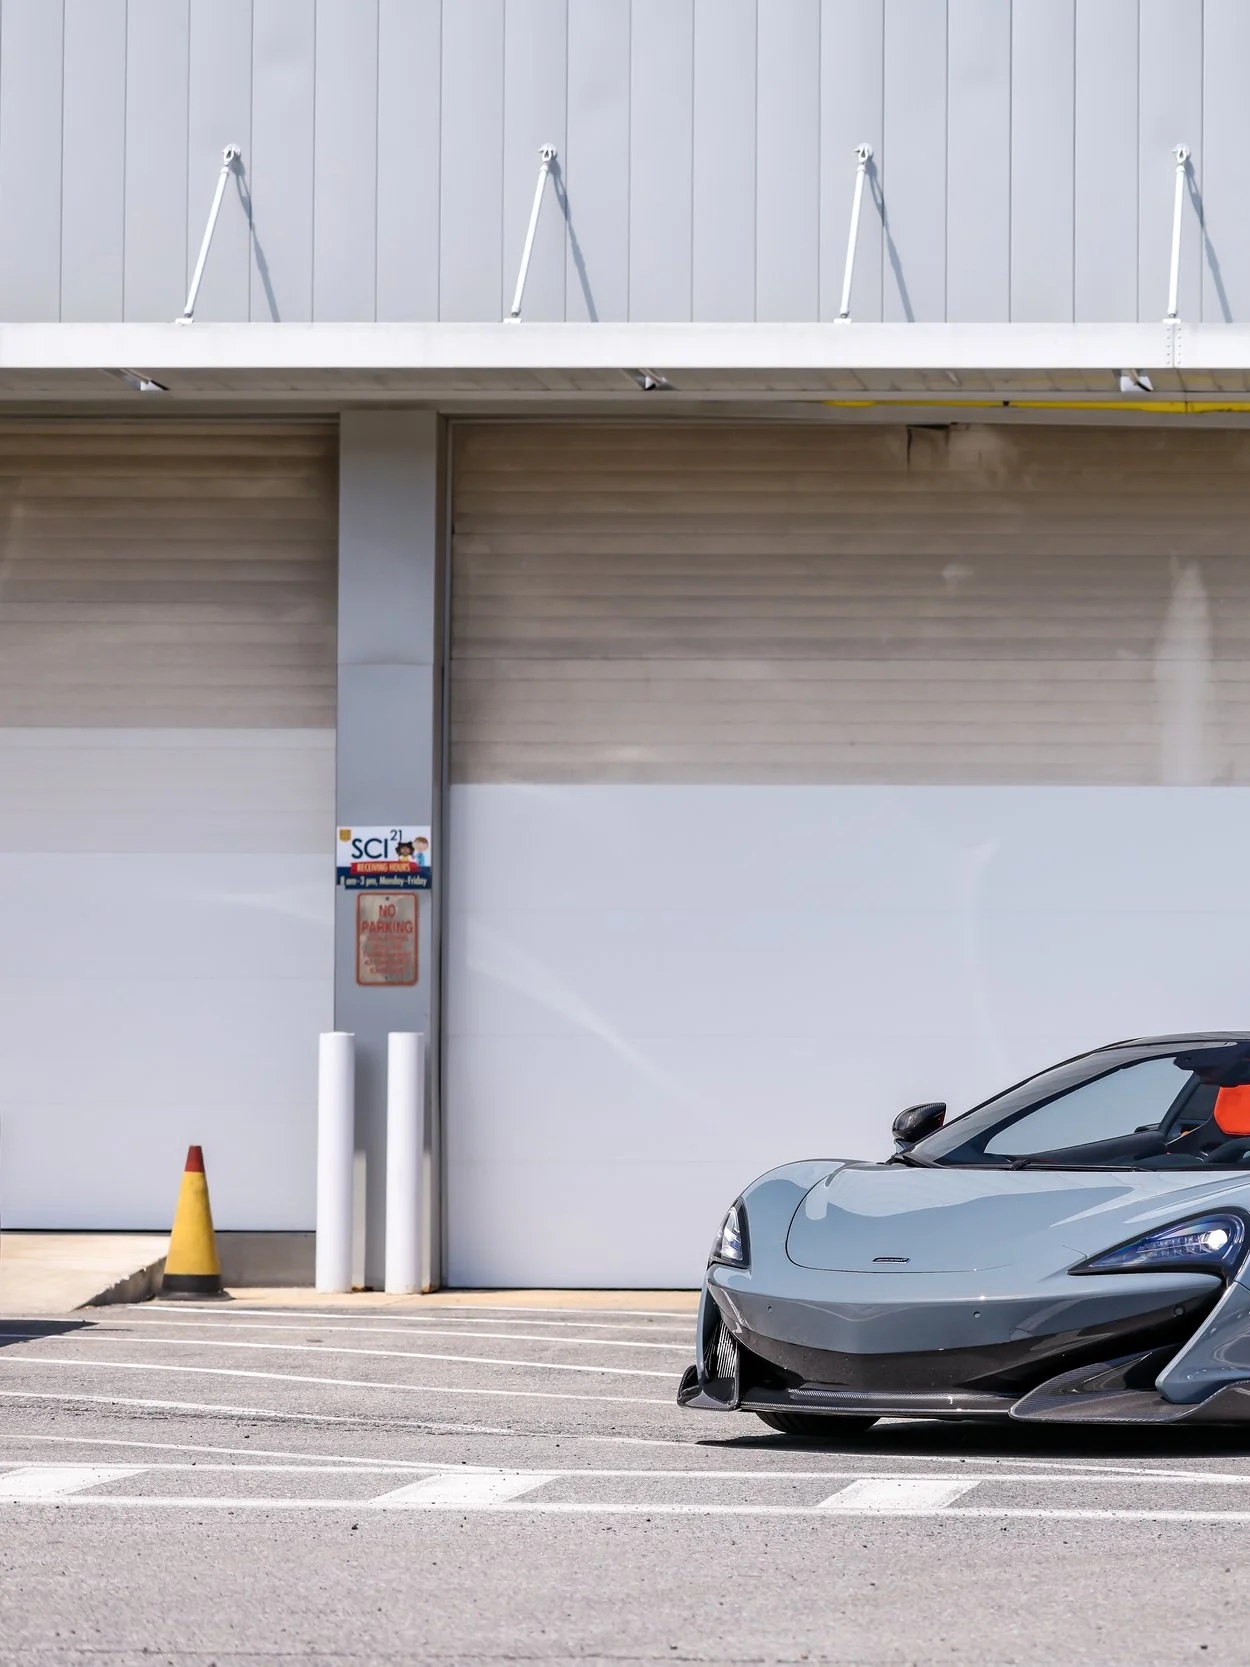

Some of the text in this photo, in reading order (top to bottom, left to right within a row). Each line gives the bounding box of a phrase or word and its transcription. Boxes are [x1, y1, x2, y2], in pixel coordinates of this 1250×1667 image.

[356, 863, 410, 872] RECEIVING HOURS
[379, 904, 396, 918] NO
[361, 920, 413, 933] PARKING
